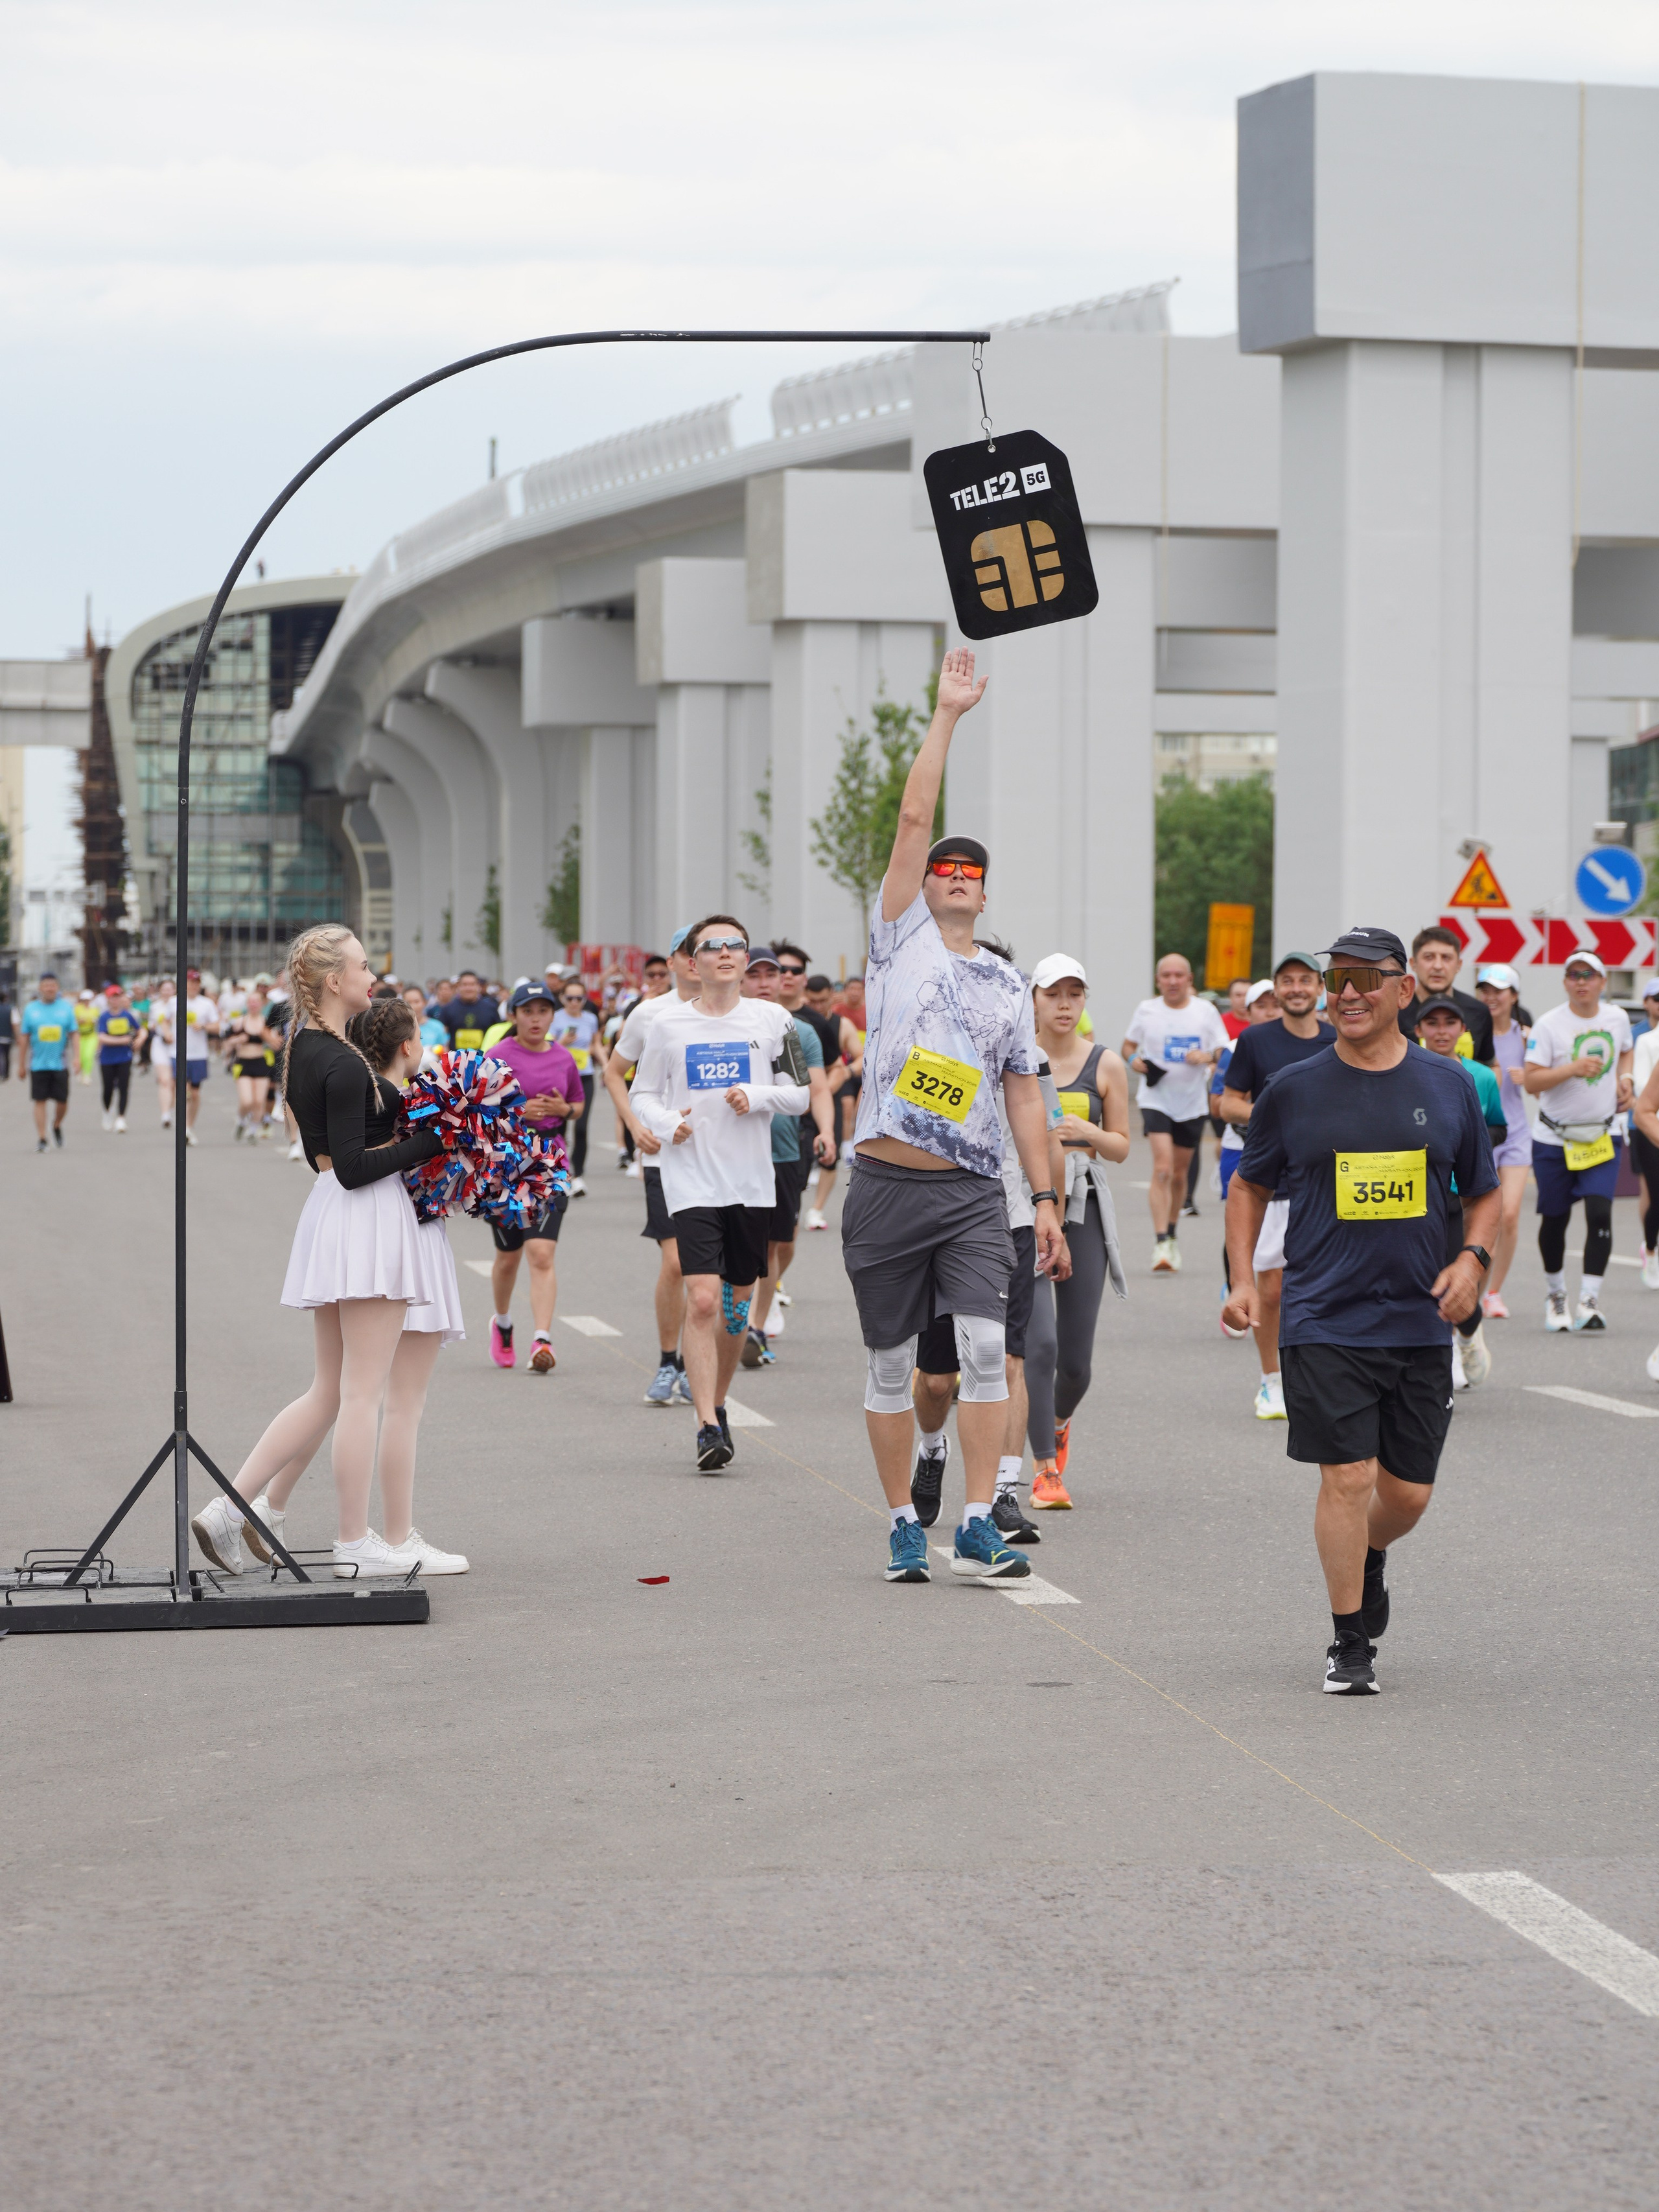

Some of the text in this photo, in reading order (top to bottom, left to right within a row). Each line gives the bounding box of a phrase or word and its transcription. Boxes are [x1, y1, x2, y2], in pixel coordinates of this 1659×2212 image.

[949, 471, 1045, 511] TELE2 5G
[912, 1051, 920, 1060] B
[923, 1059, 942, 1069] ASTANA
[946, 1058, 959, 1067] Halyk
[697, 1062, 740, 1080] 1282
[941, 1070, 966, 1083] MARATHON
[911, 1070, 964, 1106] 3278
[1340, 1161, 1349, 1172] G
[1353, 1180, 1413, 1204] 3541
